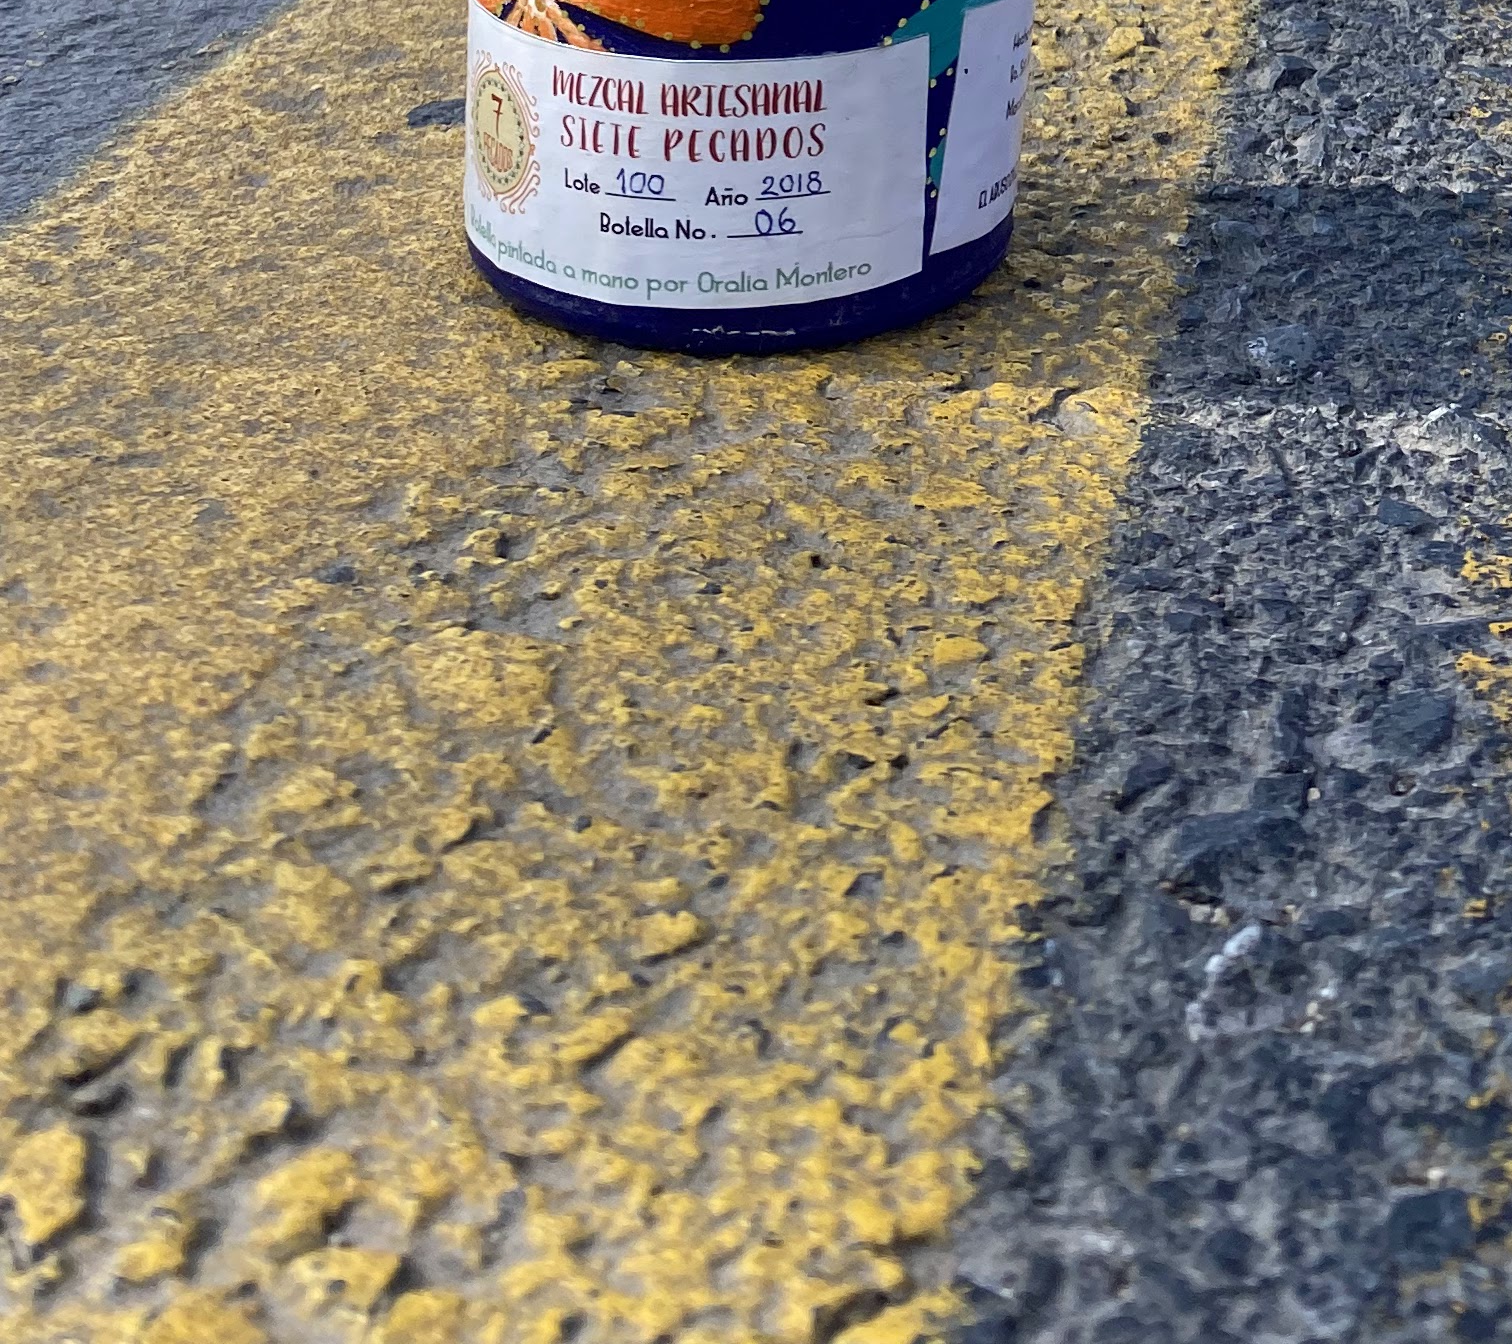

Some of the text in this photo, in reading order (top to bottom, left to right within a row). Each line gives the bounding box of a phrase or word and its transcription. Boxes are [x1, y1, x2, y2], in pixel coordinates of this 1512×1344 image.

[553, 65, 828, 118] MEZCAL ARTESANAL
[560, 114, 826, 162] SIETE PECADOS
[564, 167, 823, 207] Lote 100 Año 2018
[600, 212, 670, 239] Botella
[754, 206, 796, 234] 06
[497, 238, 558, 274] pintada
[563, 264, 577, 279] a
[581, 267, 639, 290] mano
[646, 277, 689, 300] por
[697, 270, 769, 293] Oralia
[775, 262, 872, 290] Montero
